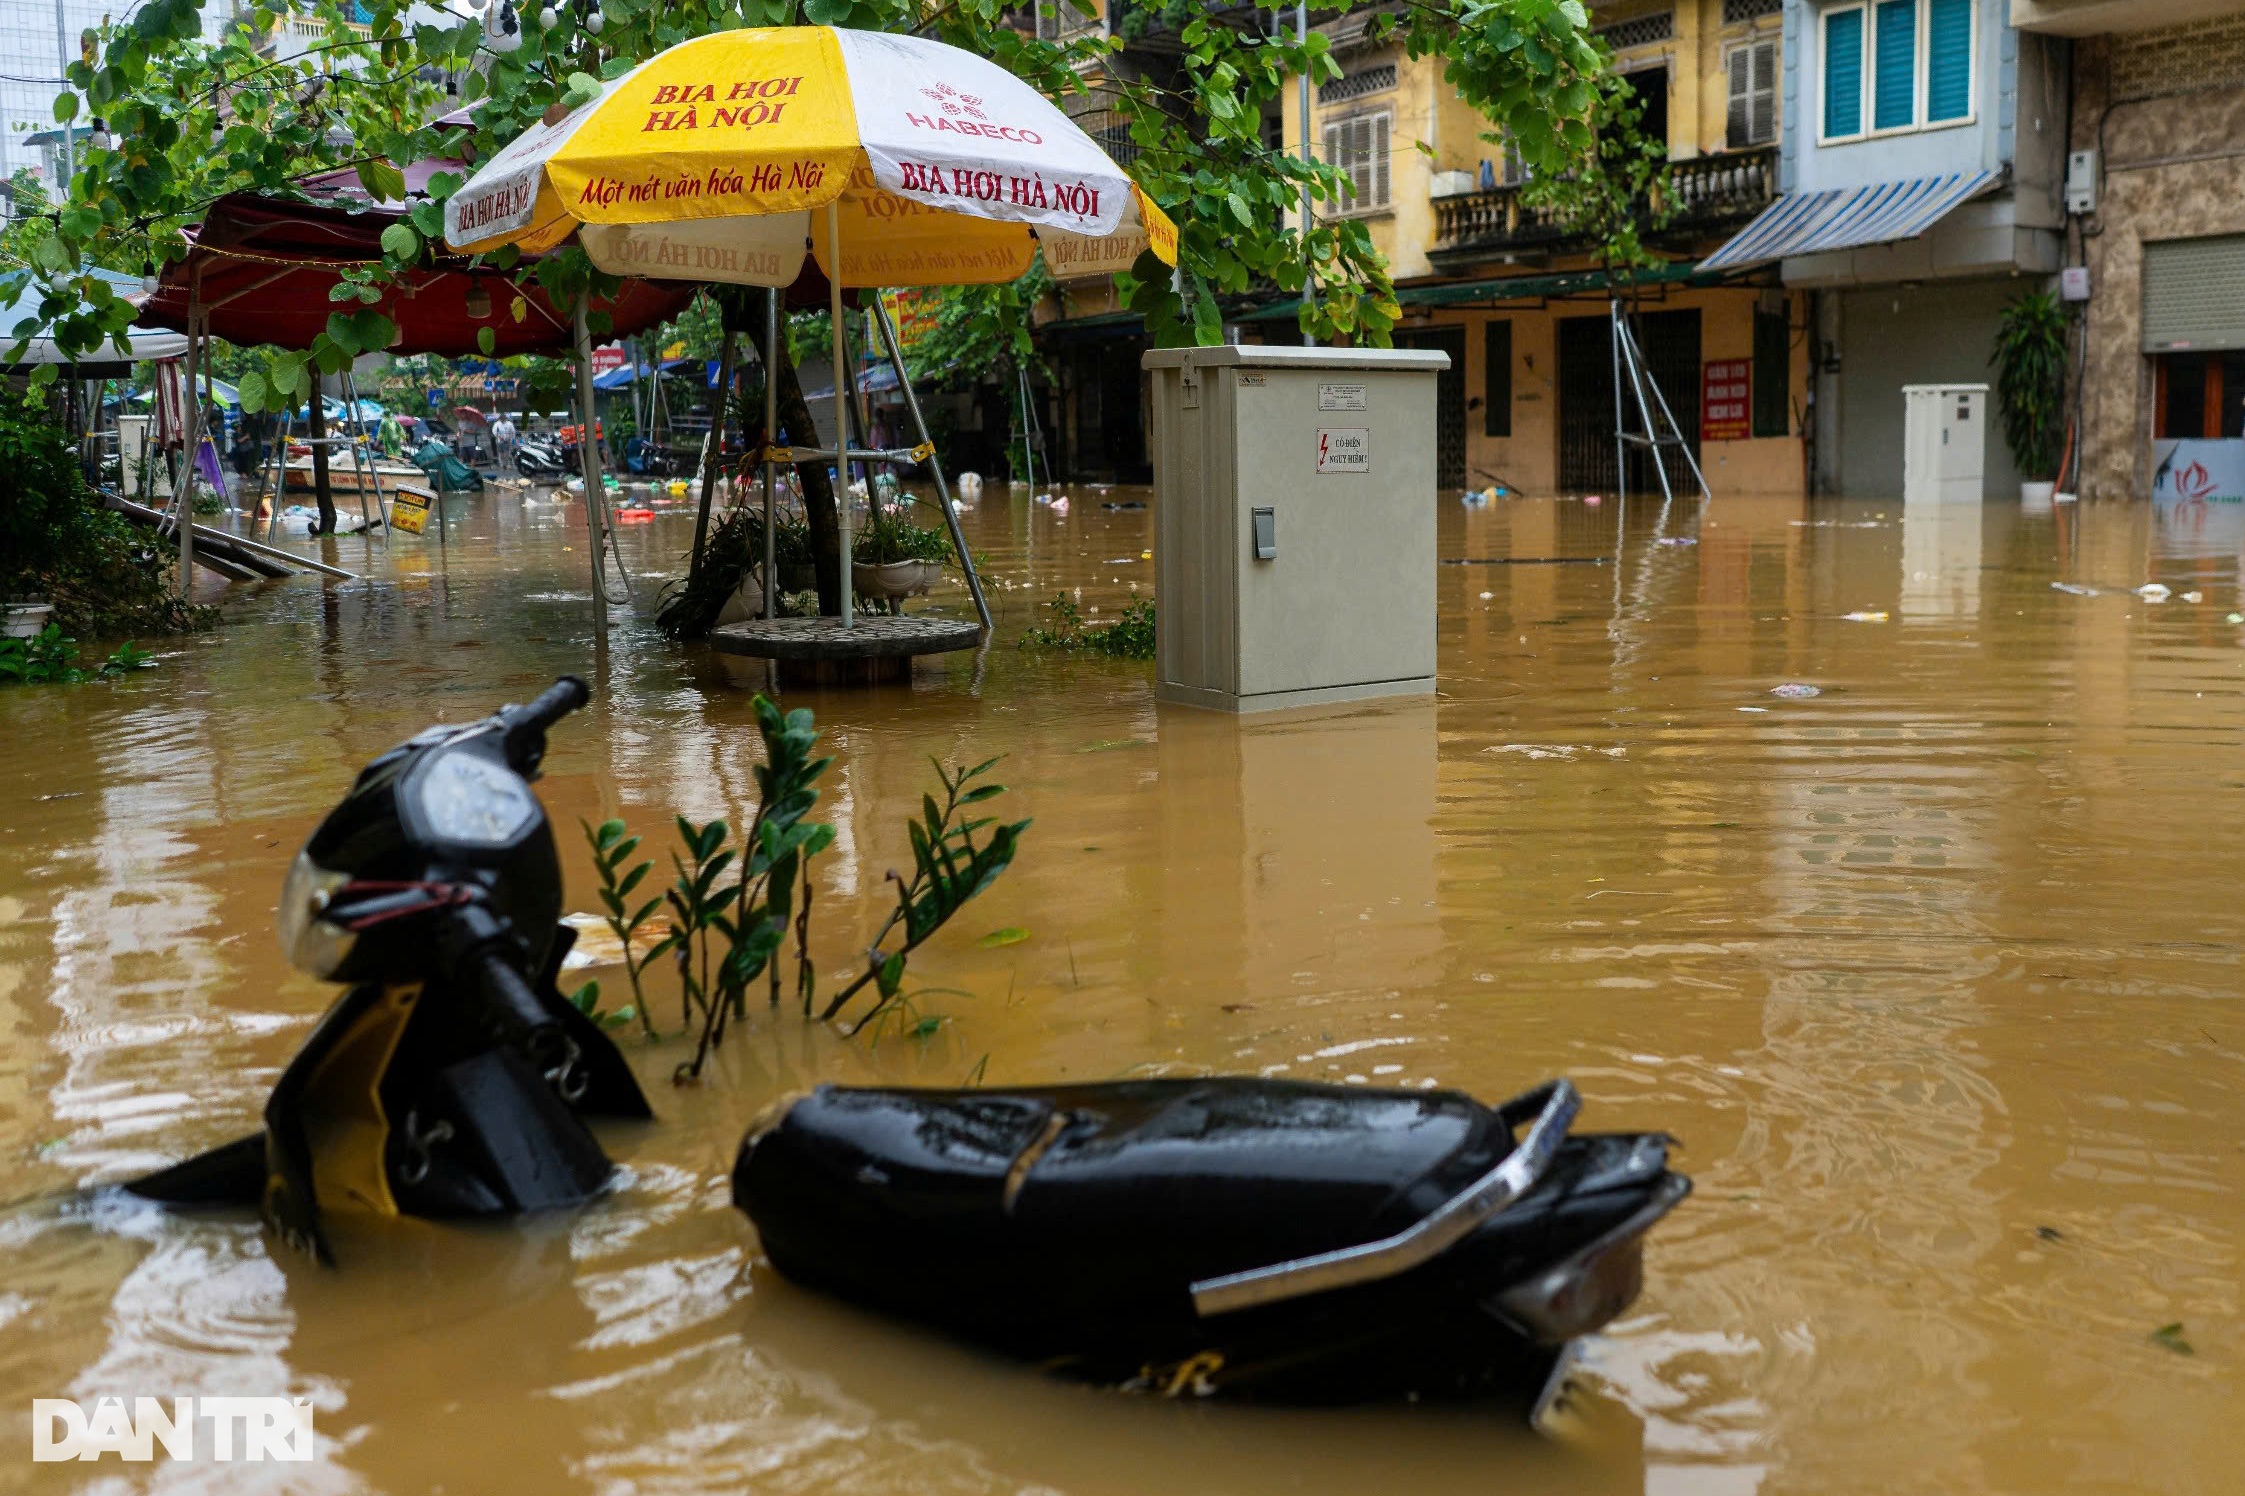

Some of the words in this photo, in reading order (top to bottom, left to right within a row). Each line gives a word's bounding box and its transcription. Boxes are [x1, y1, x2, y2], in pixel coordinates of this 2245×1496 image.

[650, 84, 716, 105] BIA
[725, 76, 804, 101] HƠI
[641, 104, 698, 132] HÀ
[707, 100, 787, 131] NỘI
[906, 112, 1043, 145] HABECO
[579, 177, 625, 210] Một
[628, 173, 661, 204] nét
[665, 171, 701, 199] văn
[707, 167, 744, 196] hóa
[750, 163, 783, 193] Hà
[787, 160, 826, 195] Nội
[898, 162, 950, 195] BIA
[952, 168, 1004, 203] HƠI
[1010, 171, 1048, 209] HÀ
[1052, 179, 1100, 222] NỘI
[457, 202, 476, 233] BIA
[1335, 437, 1345, 448] CÓ
[1329, 454, 1347, 464] NGUY
